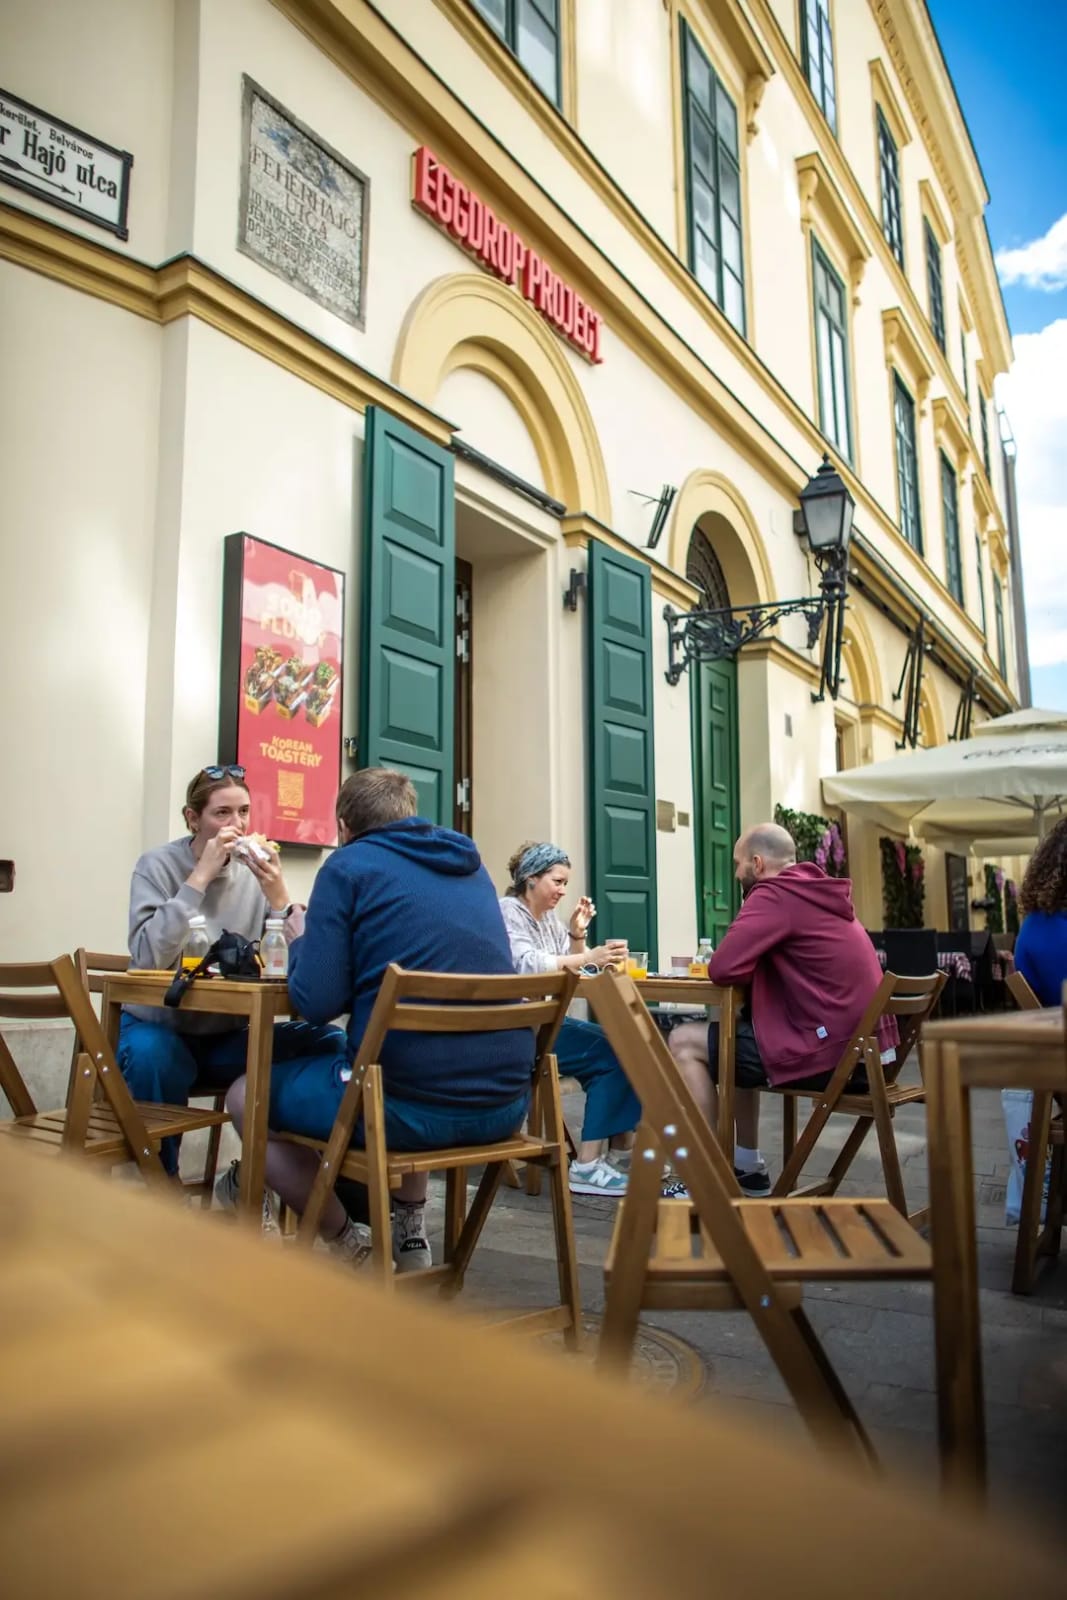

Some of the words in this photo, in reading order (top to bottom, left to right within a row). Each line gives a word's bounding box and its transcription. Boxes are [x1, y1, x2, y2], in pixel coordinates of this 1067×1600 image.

[49, 128, 94, 160] Belváros
[22, 128, 66, 176] Hajó
[76, 163, 118, 199] utca
[417, 144, 526, 288] EGGDROP
[527, 249, 604, 364] PROJECT
[259, 742, 323, 768] TOASTERY
[271, 735, 313, 753] KOREAN
